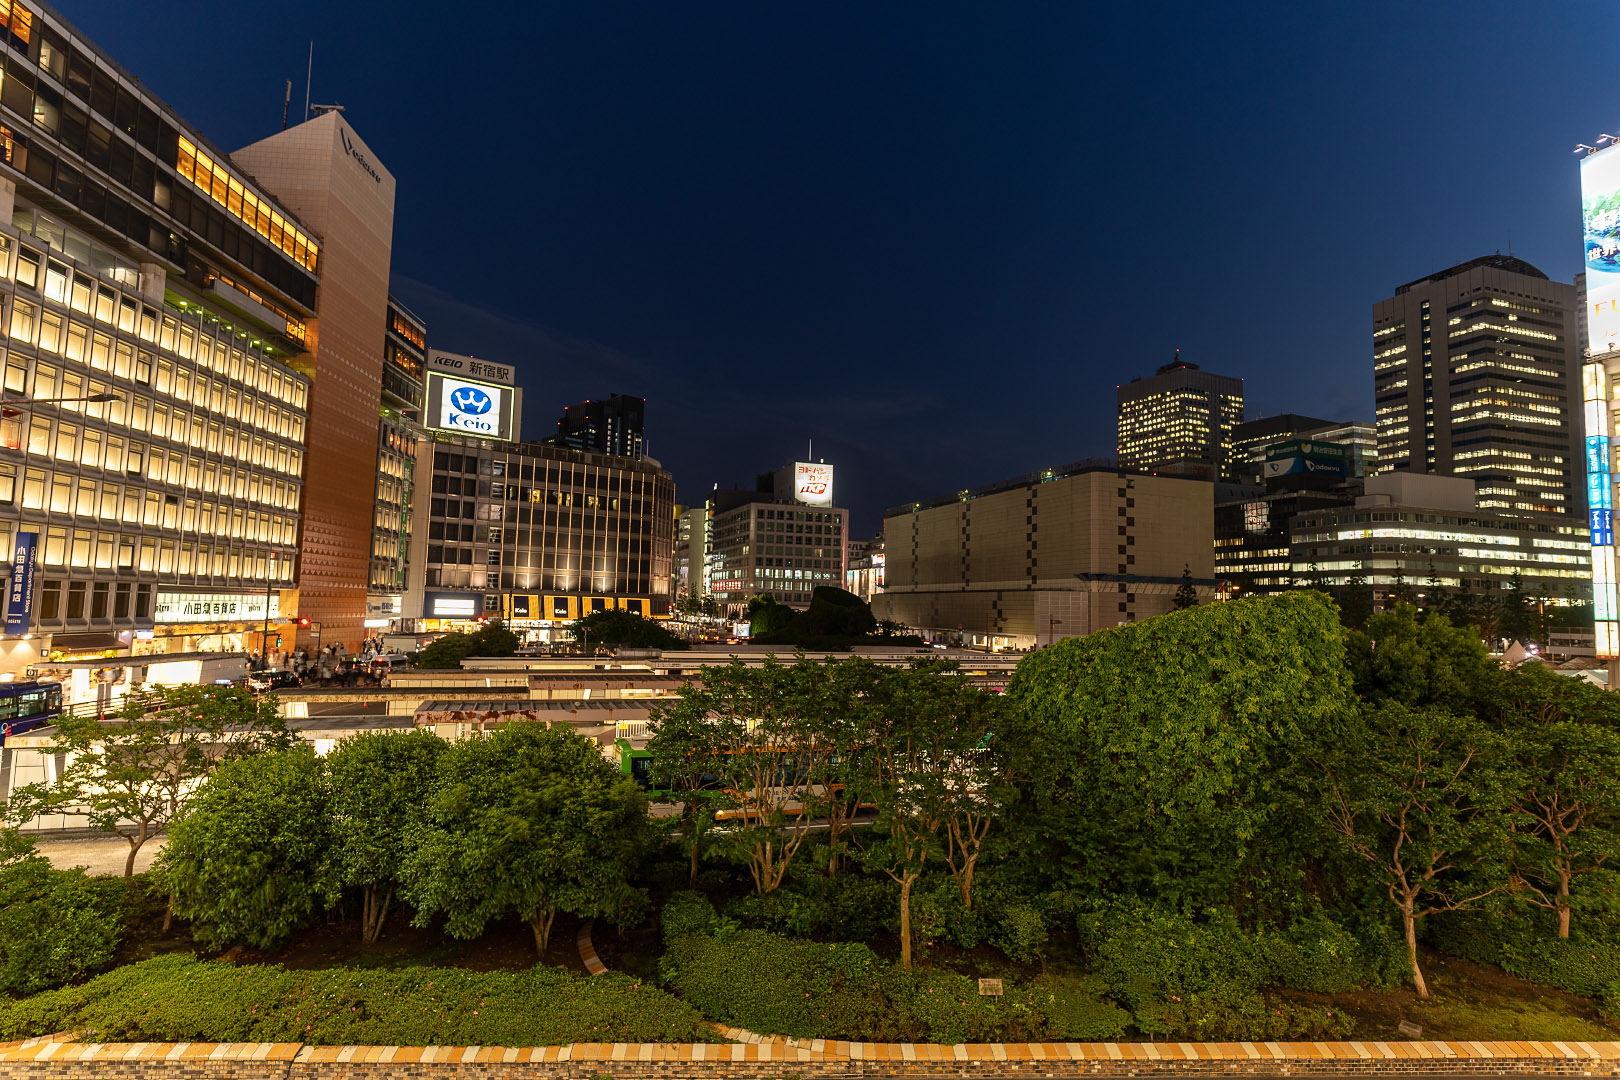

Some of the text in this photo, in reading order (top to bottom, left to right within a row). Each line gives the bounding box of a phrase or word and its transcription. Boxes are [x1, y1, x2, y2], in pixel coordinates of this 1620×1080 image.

[1588, 243, 1620, 261] 世界
[434, 356, 509, 380] KEIO 新宿駅
[449, 412, 491, 431] Keio
[12, 546, 26, 603] 小田急百貨店
[184, 602, 237, 615] 小田急百貨店
